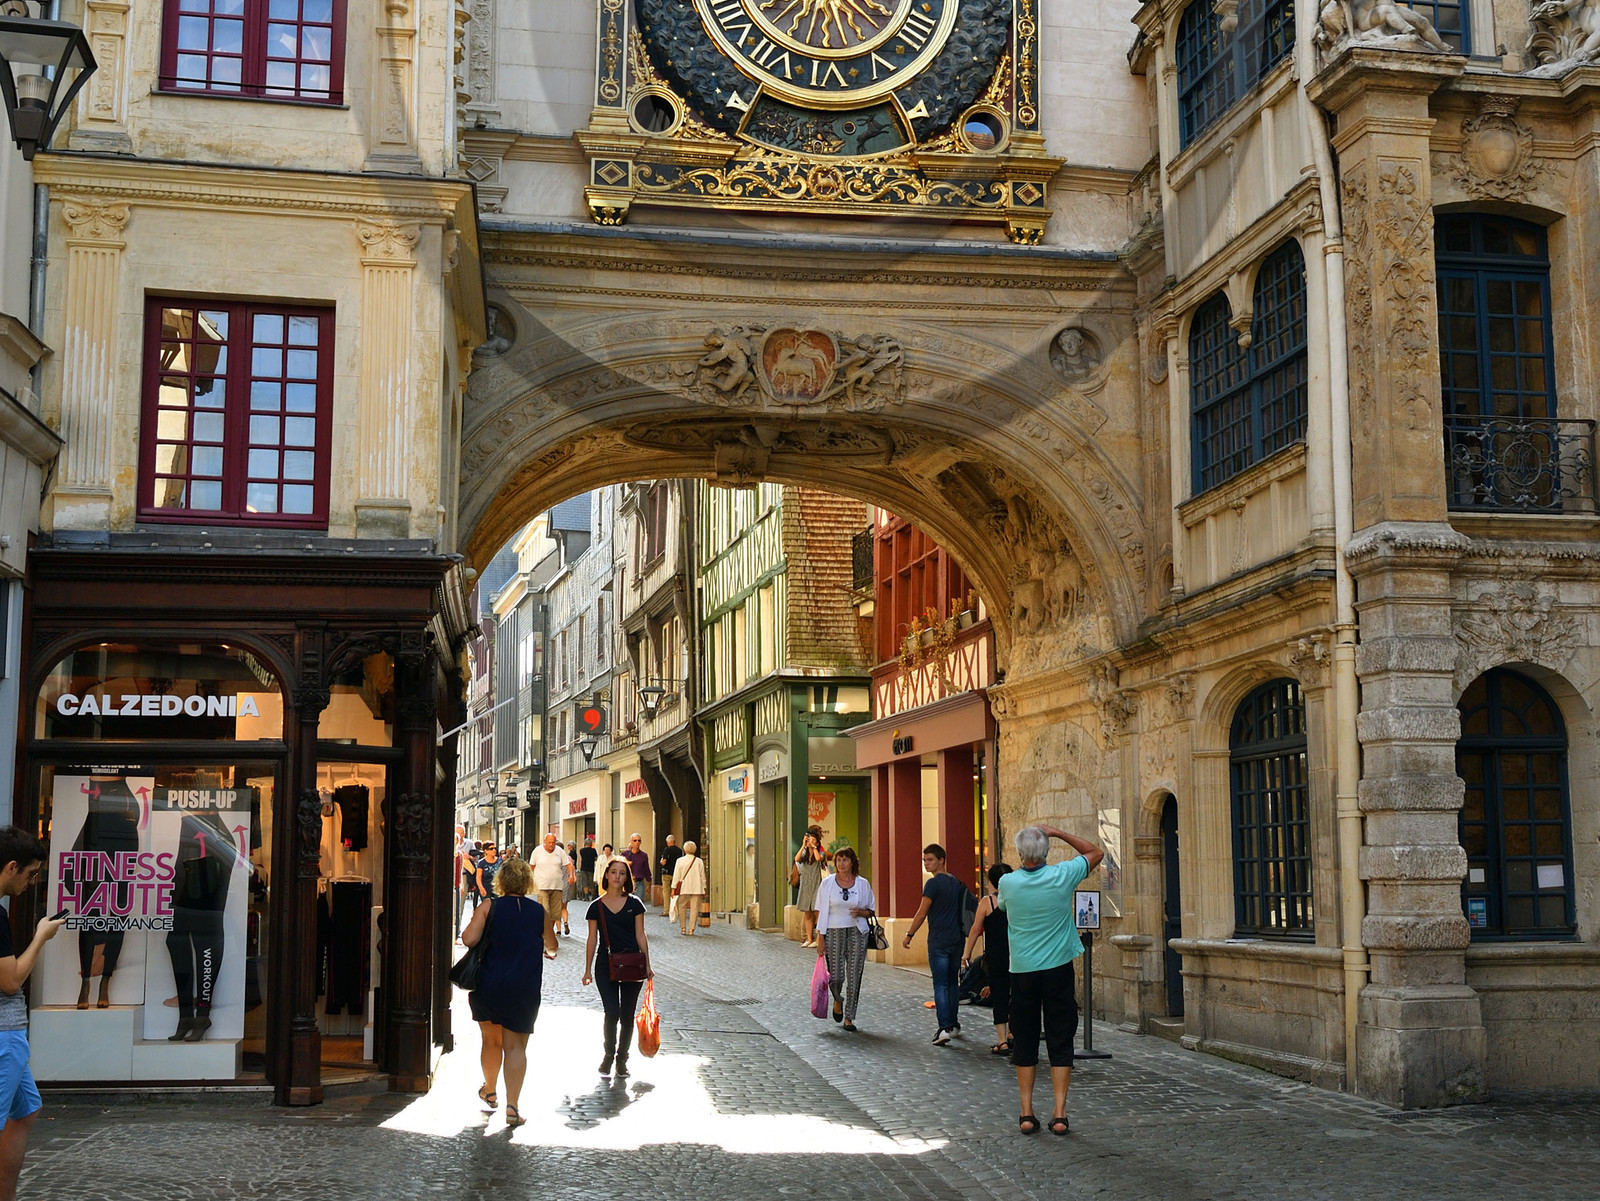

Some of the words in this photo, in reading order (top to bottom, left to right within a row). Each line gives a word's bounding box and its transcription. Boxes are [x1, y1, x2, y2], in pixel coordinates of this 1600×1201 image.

[57, 693, 260, 717] CALZEDONIA
[167, 789, 237, 809] PUSH-UP
[58, 852, 175, 881] FITNESS
[57, 883, 174, 916] HAUTE
[65, 917, 174, 931] ERFORMANCE
[202, 948, 212, 1002] WORKOUT
